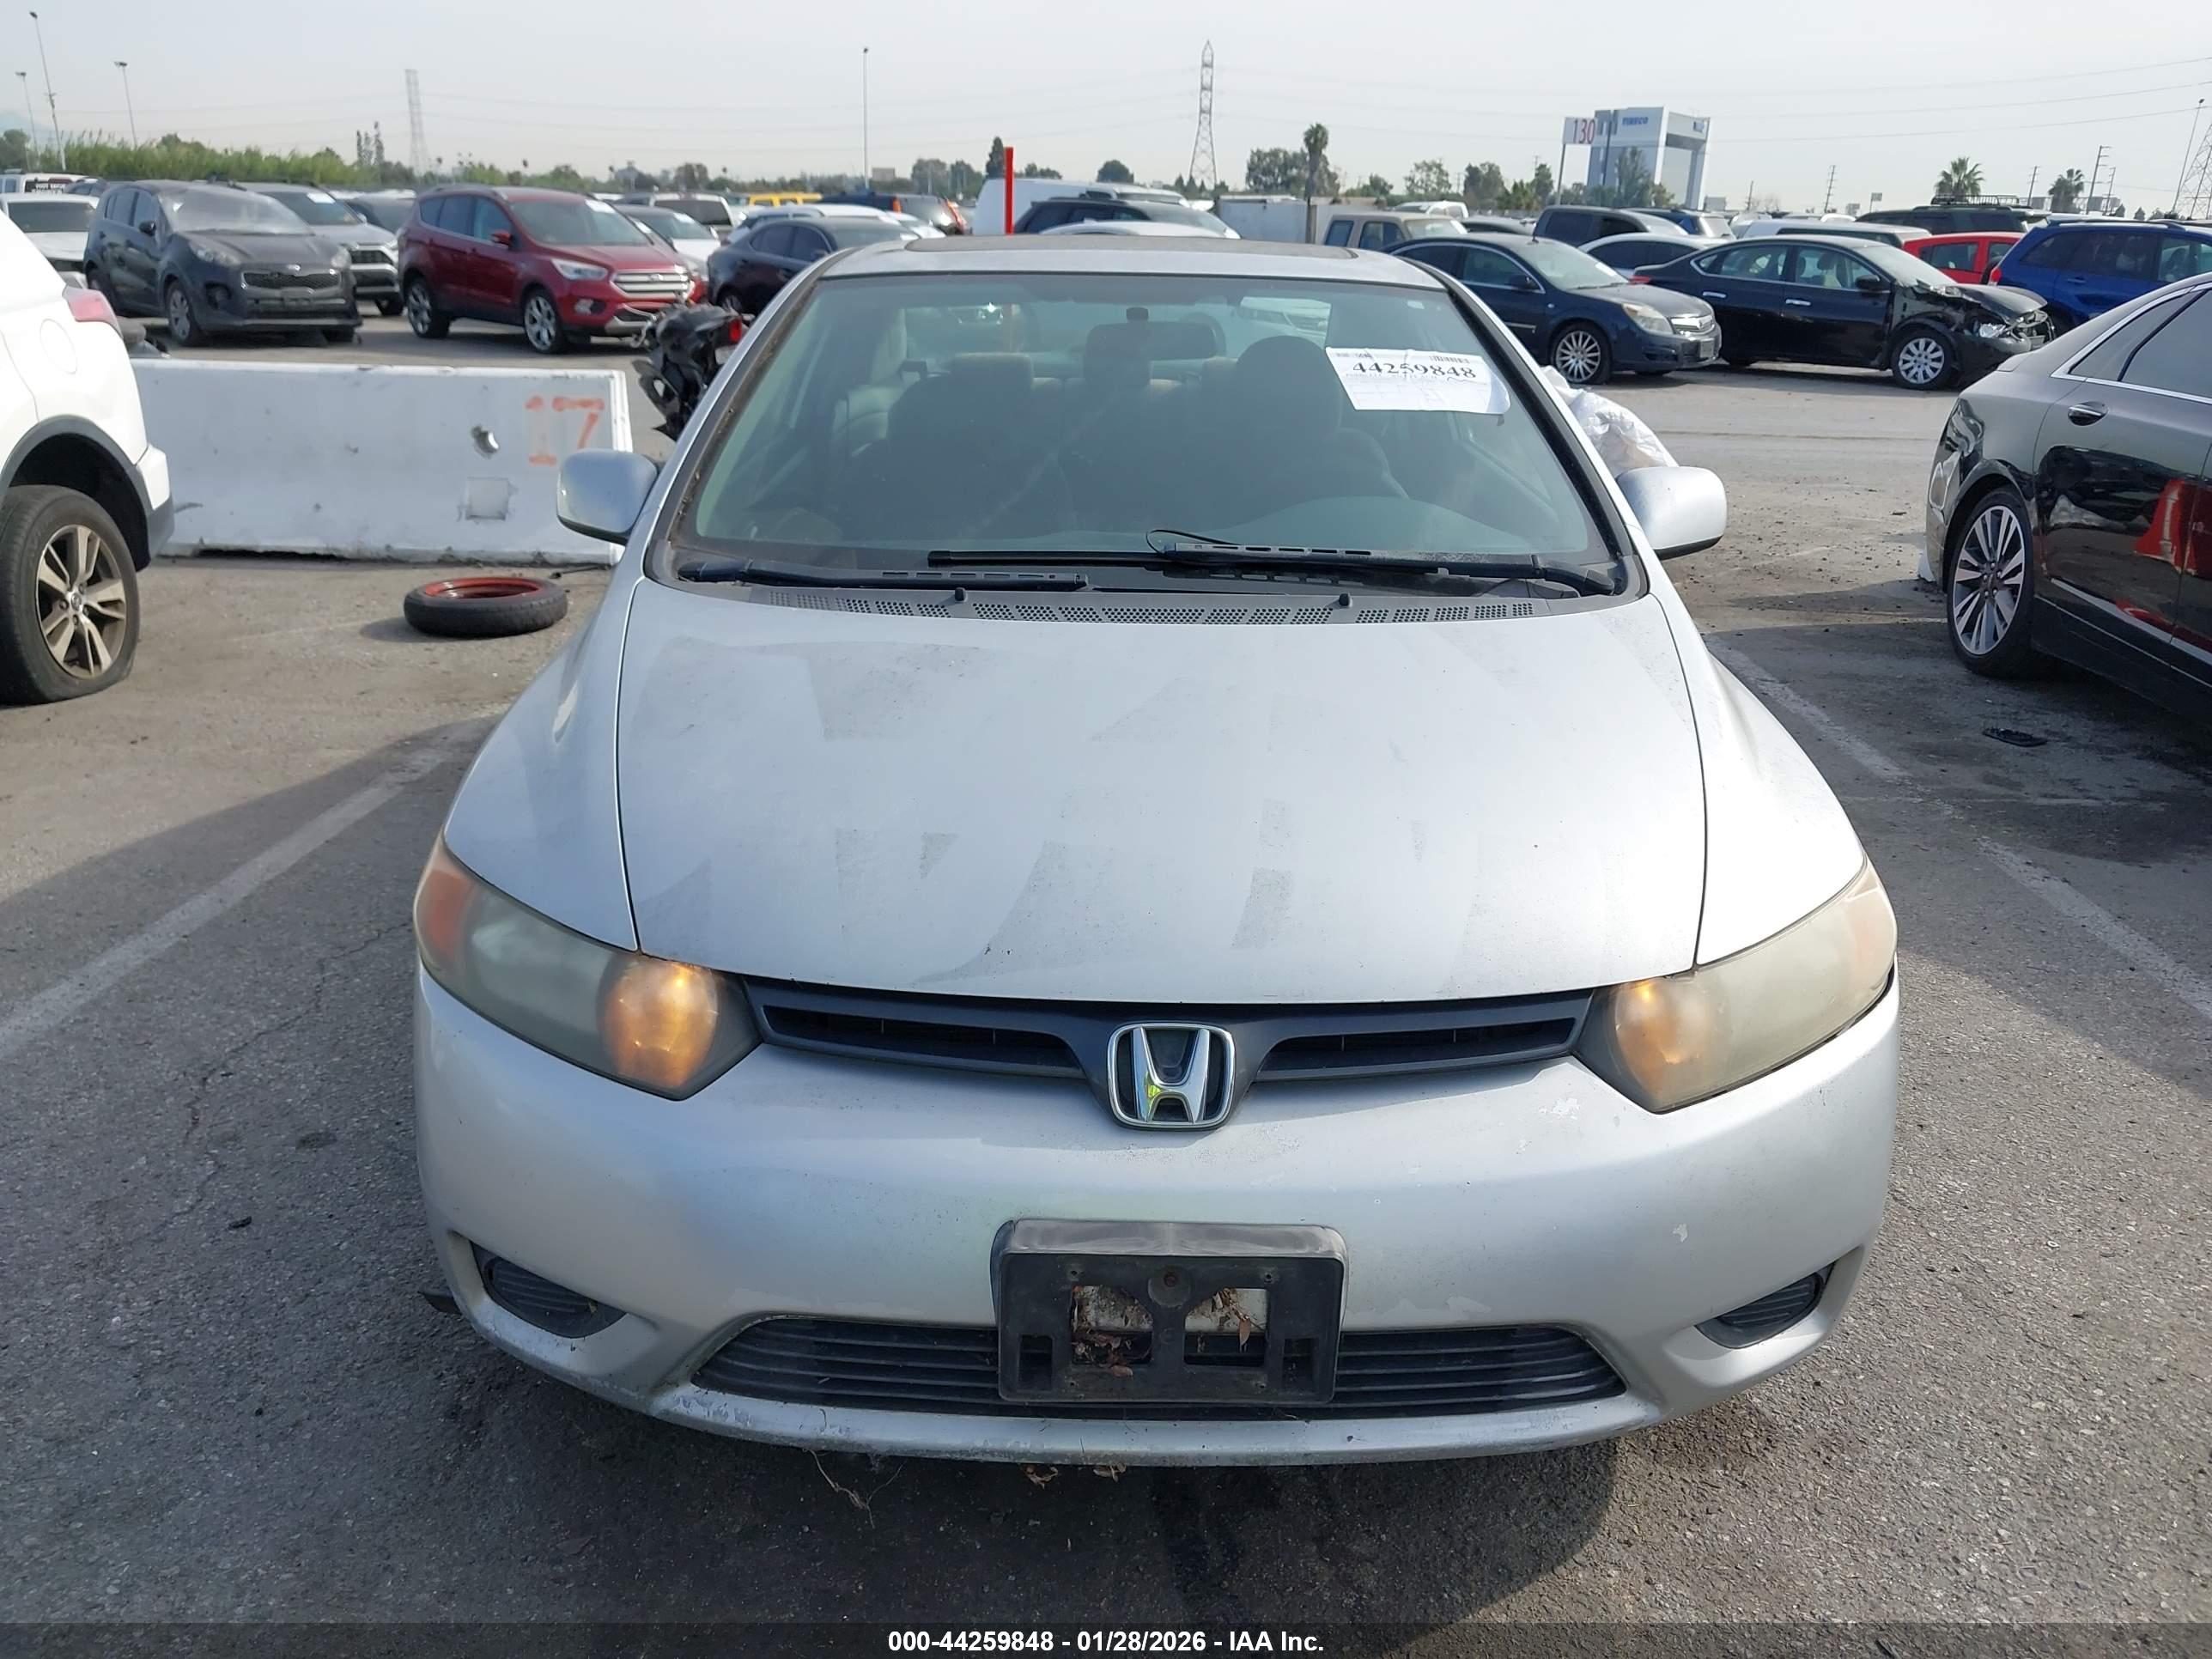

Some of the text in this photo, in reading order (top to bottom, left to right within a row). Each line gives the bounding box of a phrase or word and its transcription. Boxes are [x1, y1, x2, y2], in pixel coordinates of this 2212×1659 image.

[1572, 118, 1595, 145] 130
[1352, 362, 1477, 379] 44259848
[525, 395, 605, 466] 17
